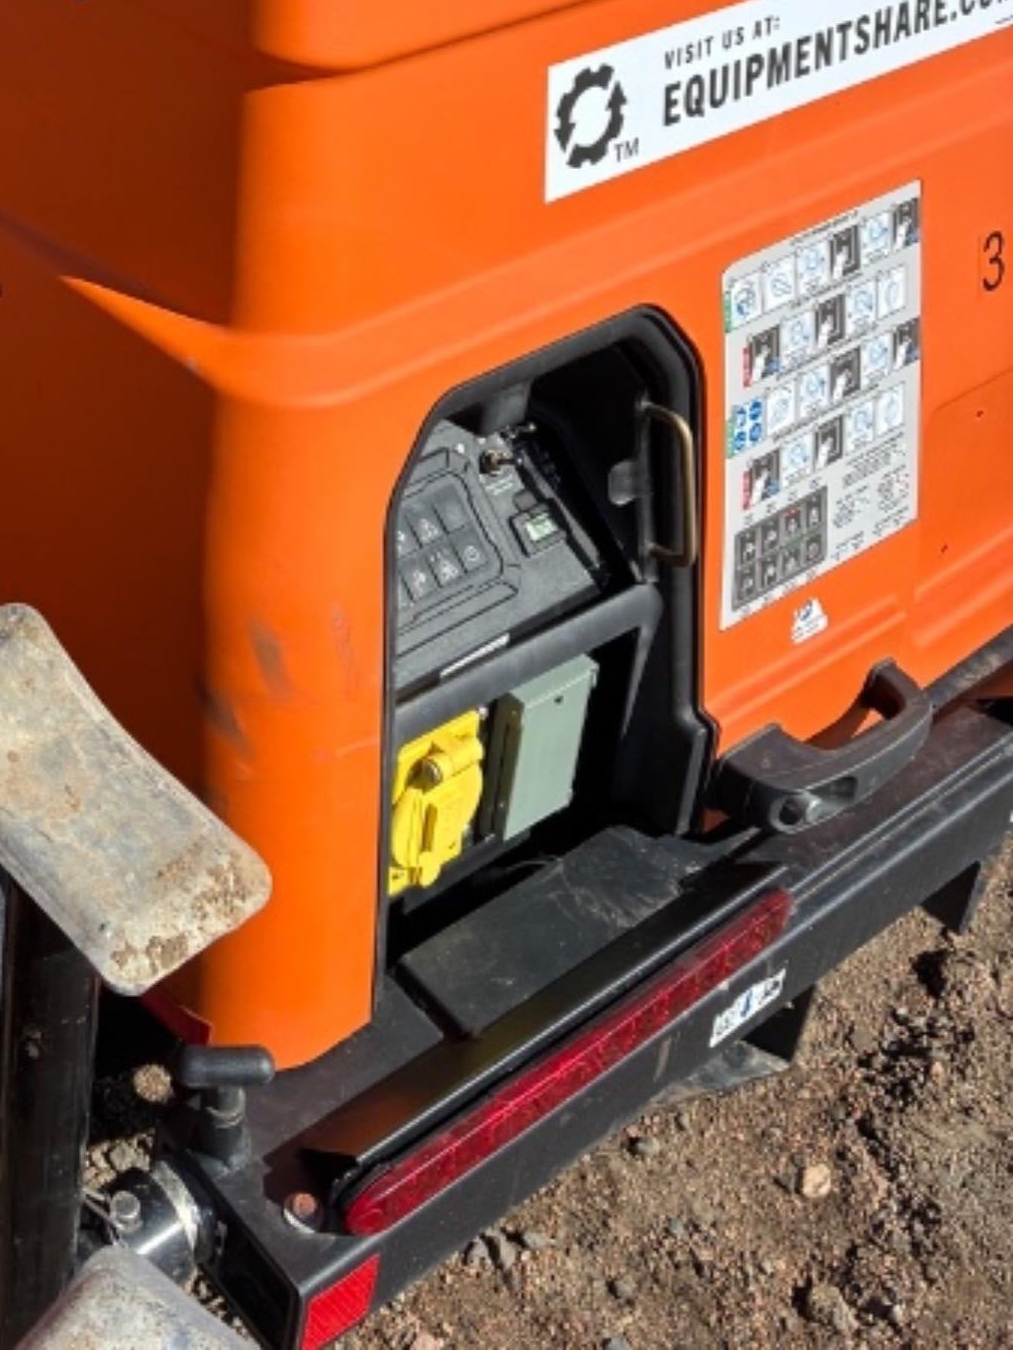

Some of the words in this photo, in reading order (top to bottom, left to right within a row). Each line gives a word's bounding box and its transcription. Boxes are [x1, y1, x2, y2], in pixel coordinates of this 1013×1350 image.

[664, 36, 714, 69] VISIT
[722, 29, 746, 51] US
[751, 15, 781, 42] AT:
[982, 230, 1005, 292] 3
